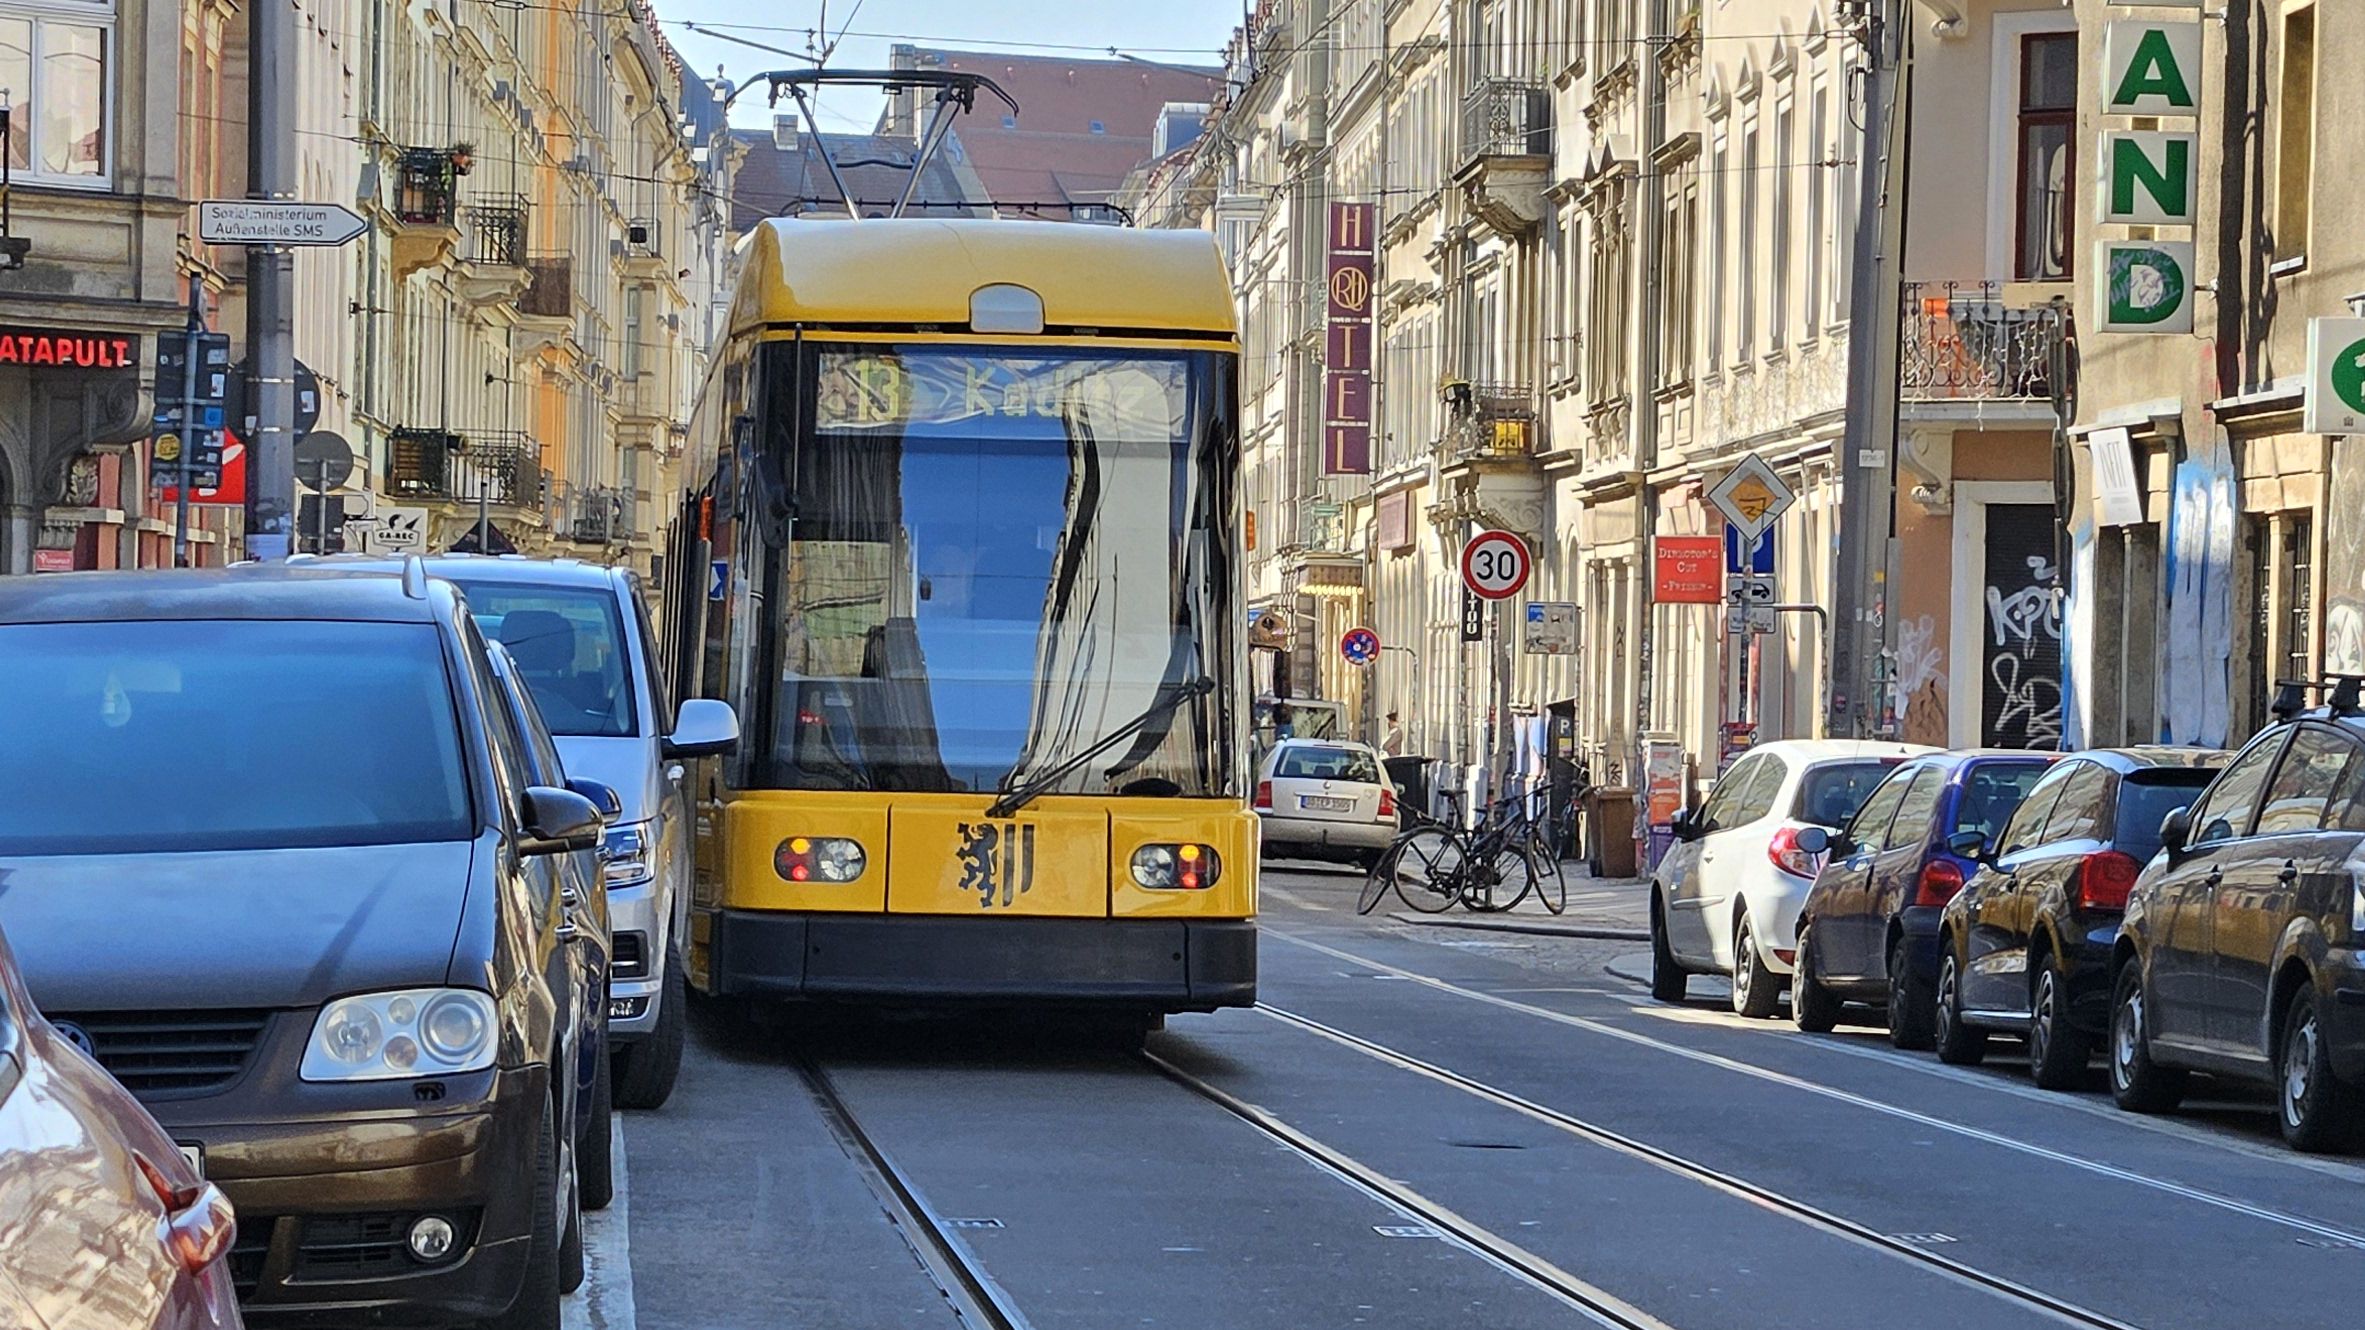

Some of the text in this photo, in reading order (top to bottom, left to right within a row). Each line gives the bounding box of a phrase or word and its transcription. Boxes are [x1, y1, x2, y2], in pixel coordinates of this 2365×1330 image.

[212, 207, 327, 221] Sozialministerium
[215, 222, 323, 237] Außenstelle SMS
[1331, 205, 1368, 472] HOTEL
[858, 358, 899, 421] 13
[1476, 550, 1515, 580] 30
[1560, 719, 1570, 734] P
